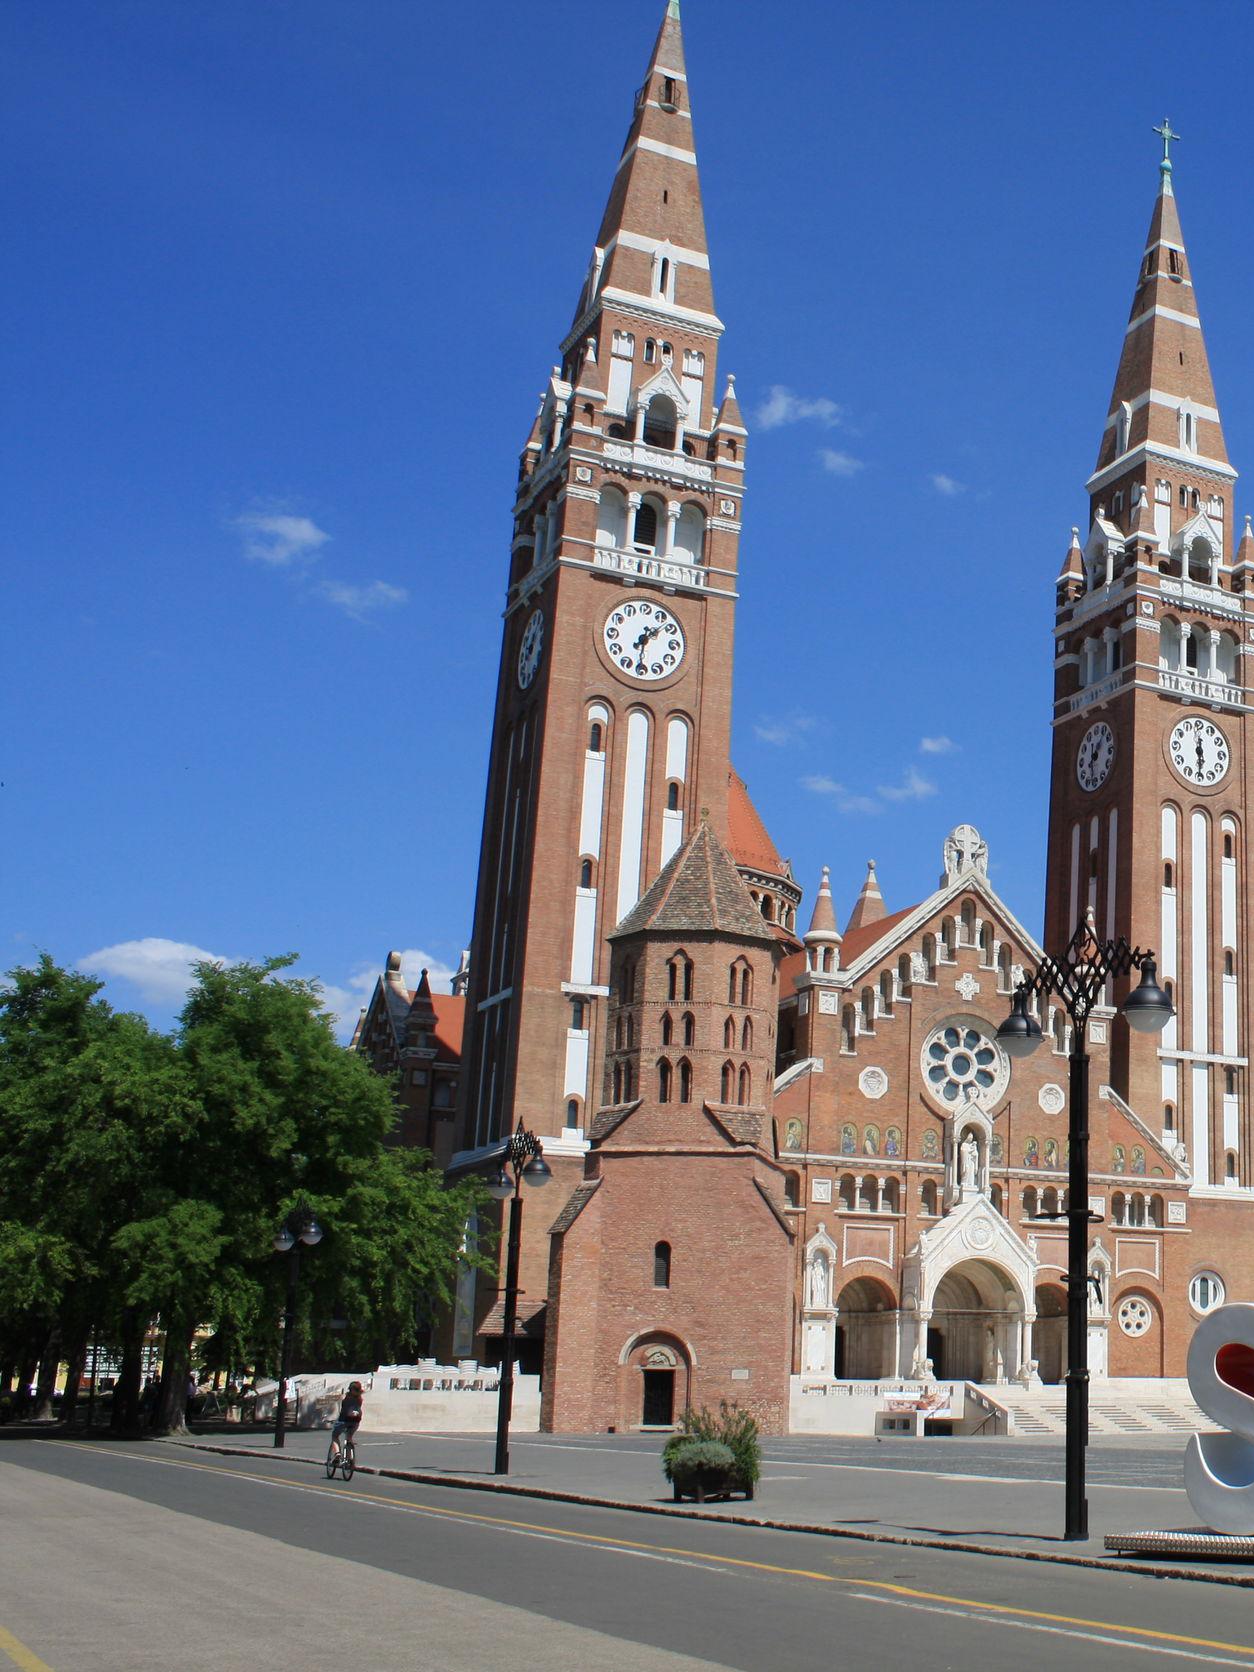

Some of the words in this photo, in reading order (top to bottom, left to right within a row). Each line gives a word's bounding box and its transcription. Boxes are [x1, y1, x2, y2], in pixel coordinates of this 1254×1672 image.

[641, 604, 652, 615] 12
[657, 611, 666, 623] 1
[607, 628, 618, 640] 9
[666, 624, 676, 635] 2
[610, 643, 621, 655] 8
[669, 639, 680, 651] 3
[622, 657, 632, 669] 7
[664, 654, 675, 666] 4
[652, 663, 663, 675] 5
